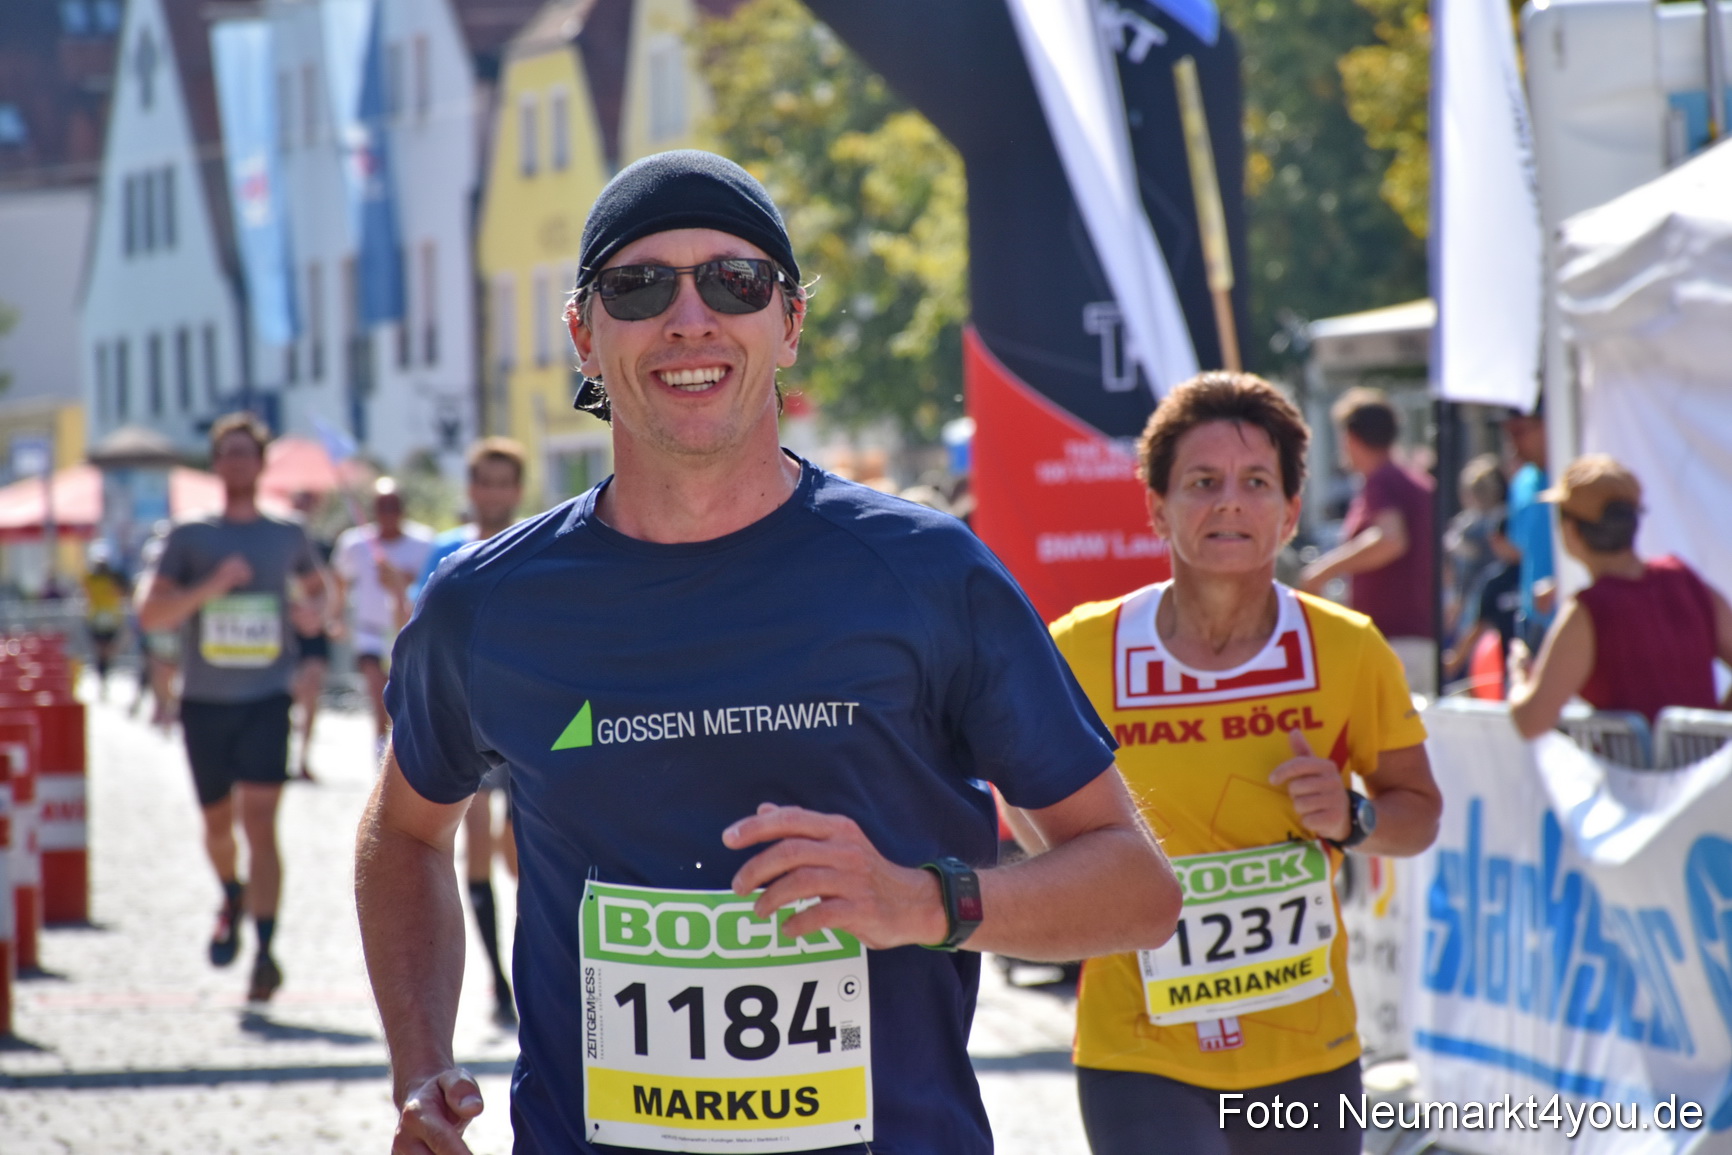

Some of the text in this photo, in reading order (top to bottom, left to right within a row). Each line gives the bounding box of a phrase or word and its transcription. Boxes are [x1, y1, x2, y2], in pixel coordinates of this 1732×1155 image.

[598, 702, 859, 744] GOSSEN METRAWATT
[1115, 706, 1323, 746] MAX BÖGL
[1176, 896, 1307, 966] 1237
[843, 981, 856, 996] C
[1169, 957, 1314, 1006] MARIANNE
[614, 980, 837, 1061] 1184
[633, 1085, 820, 1121] MARKUS
